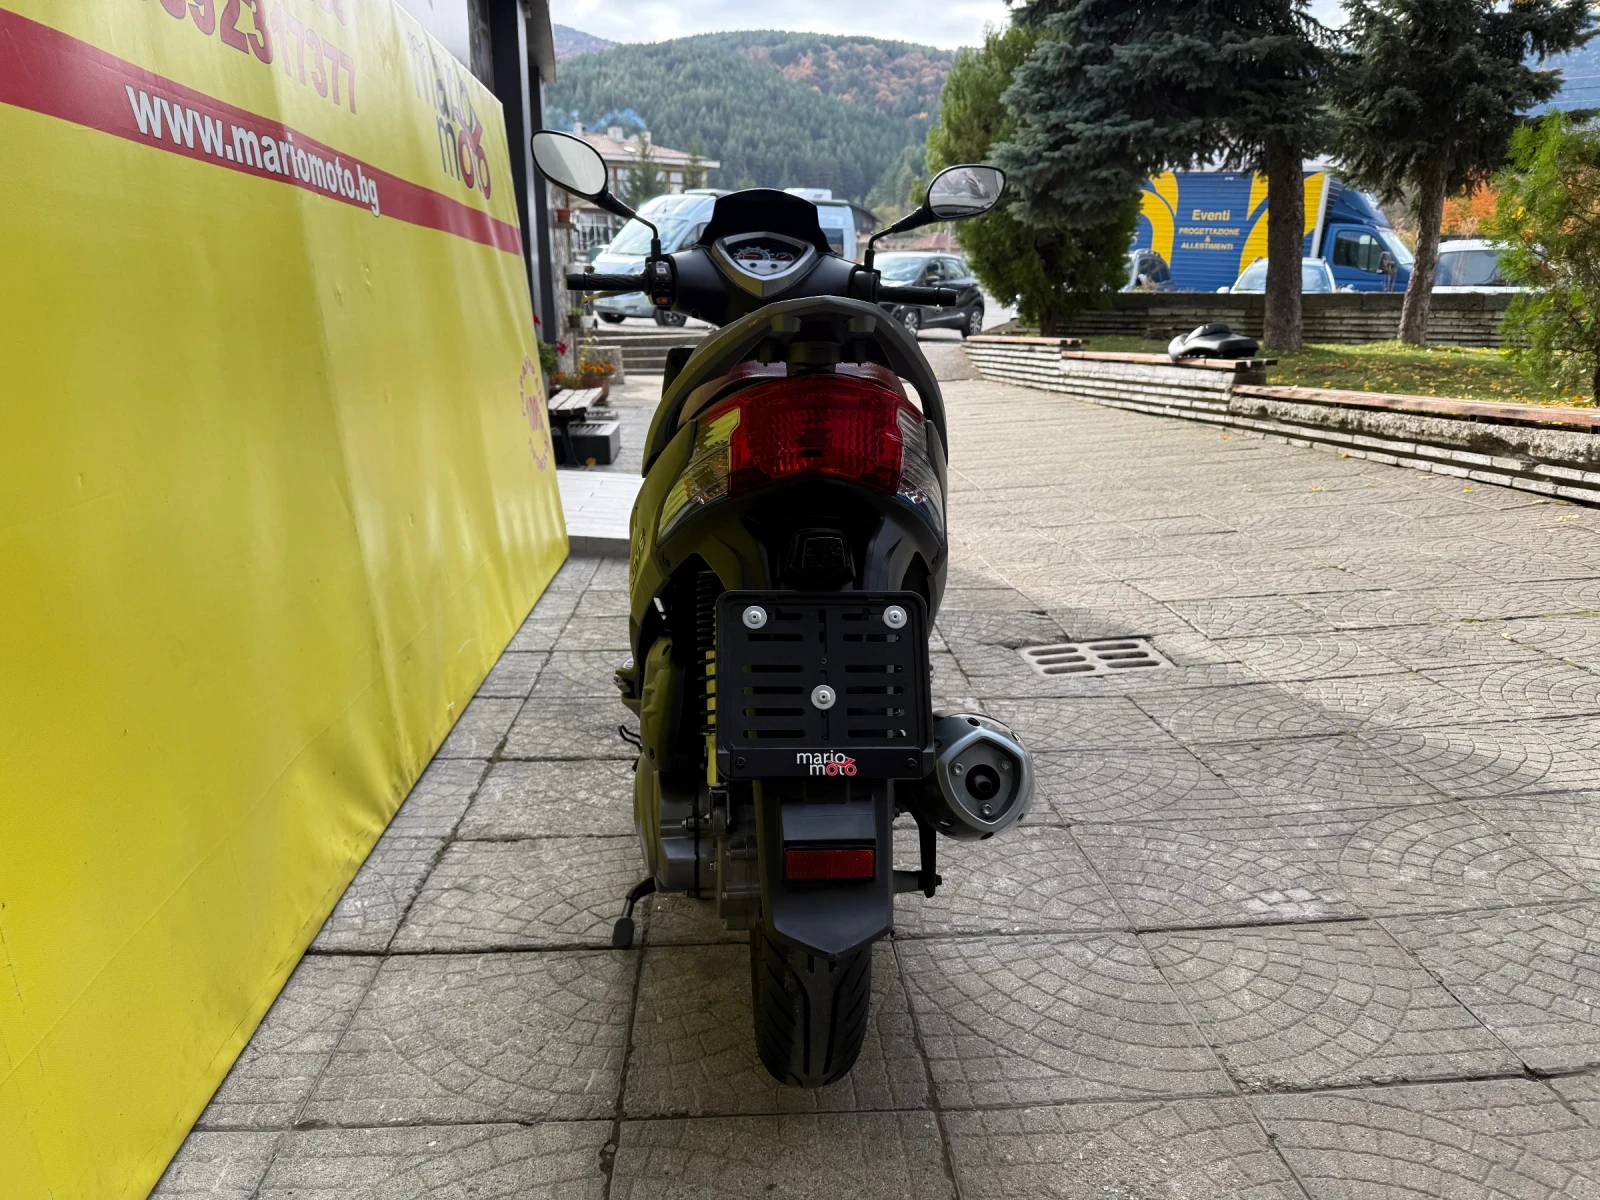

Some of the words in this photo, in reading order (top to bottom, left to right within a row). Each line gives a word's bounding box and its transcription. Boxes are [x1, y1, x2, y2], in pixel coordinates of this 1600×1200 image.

[160, 0, 357, 115] 92317377
[124, 84, 381, 217] www.mariomoto.bg
[436, 115, 491, 200] moto
[1191, 209, 1231, 221] Eventi
[1178, 227, 1240, 236] PROGETTAZIONE
[1180, 242, 1234, 251] ALLESTIMENTI
[796, 750, 846, 764] mario
[809, 763, 858, 777] moto
